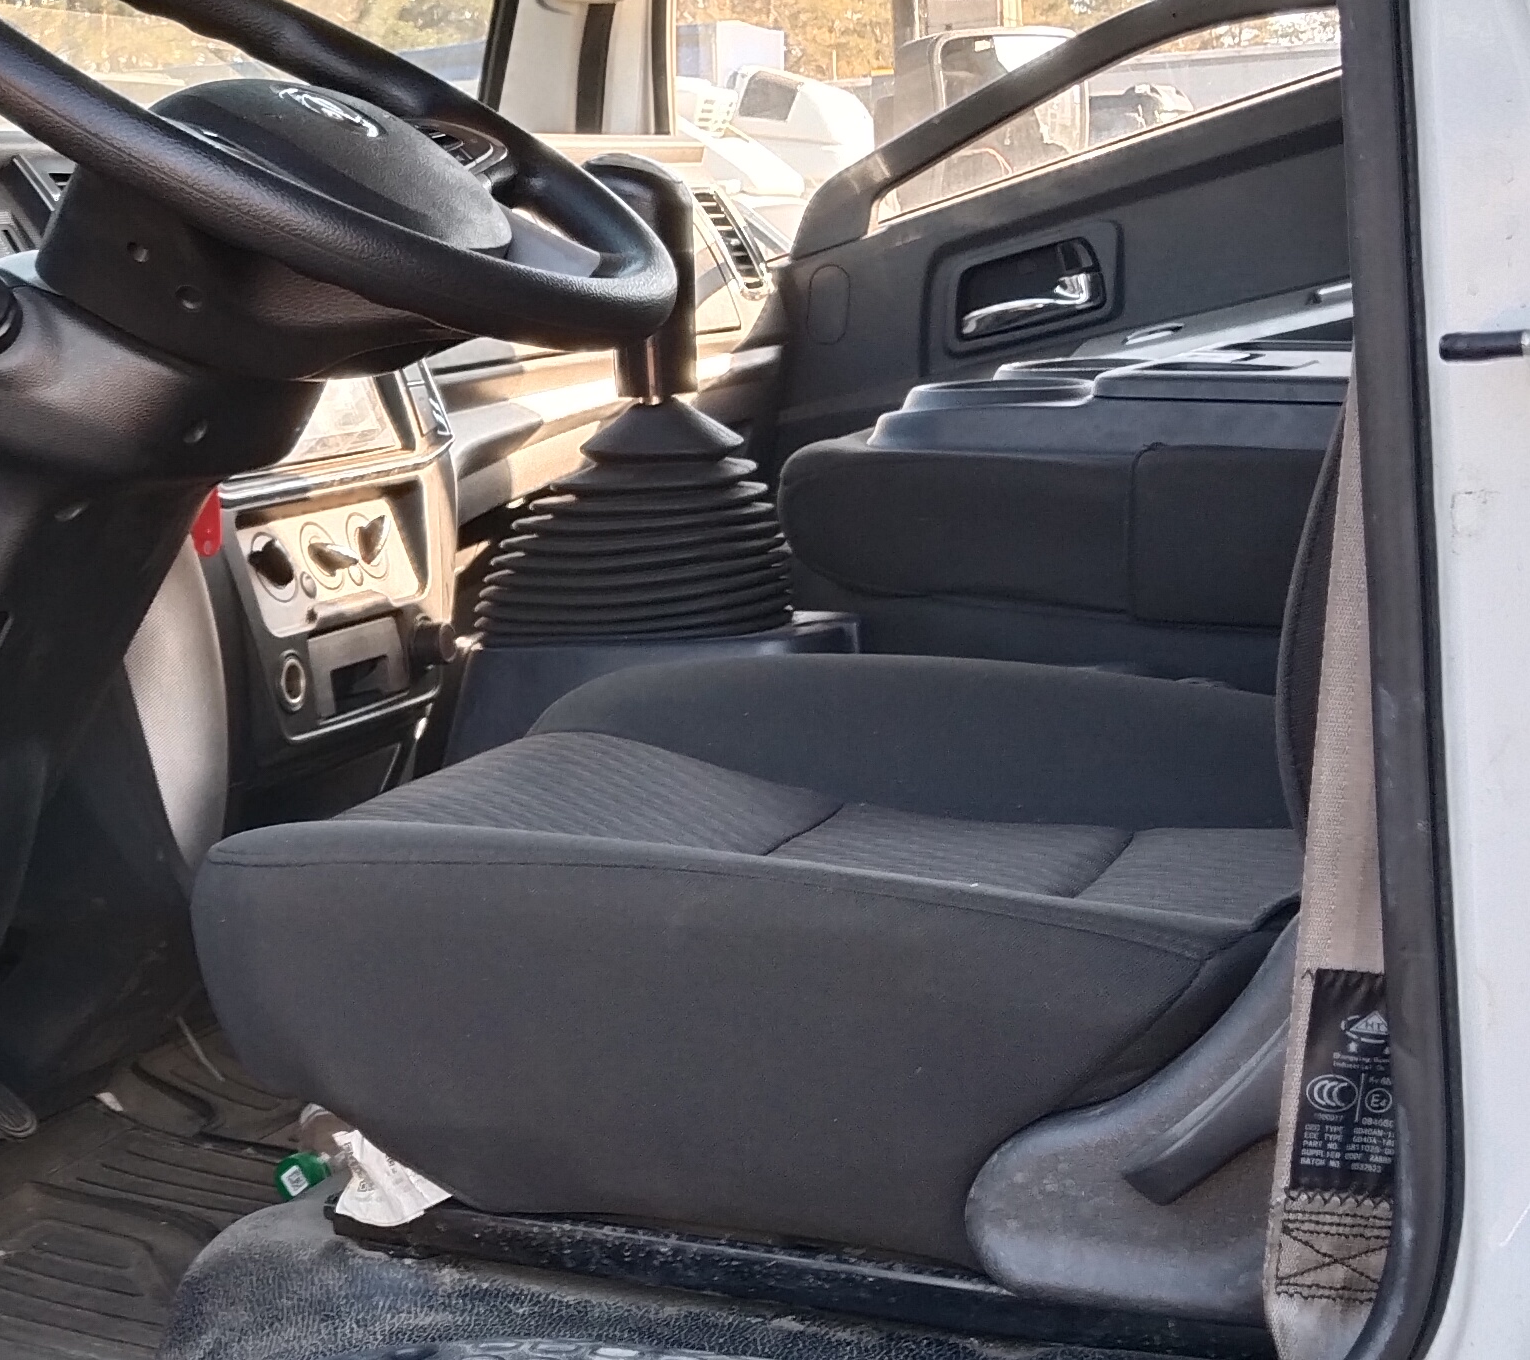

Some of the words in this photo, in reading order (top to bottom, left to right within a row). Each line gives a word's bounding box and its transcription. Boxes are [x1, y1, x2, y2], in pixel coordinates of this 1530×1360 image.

[1325, 1124, 1344, 1134] TYPE
[1324, 1133, 1344, 1143] TYPE
[1302, 1139, 1323, 1148] PART
[1301, 1148, 1341, 1159] SUPPLIER
[1300, 1157, 1326, 1167] BATCH
